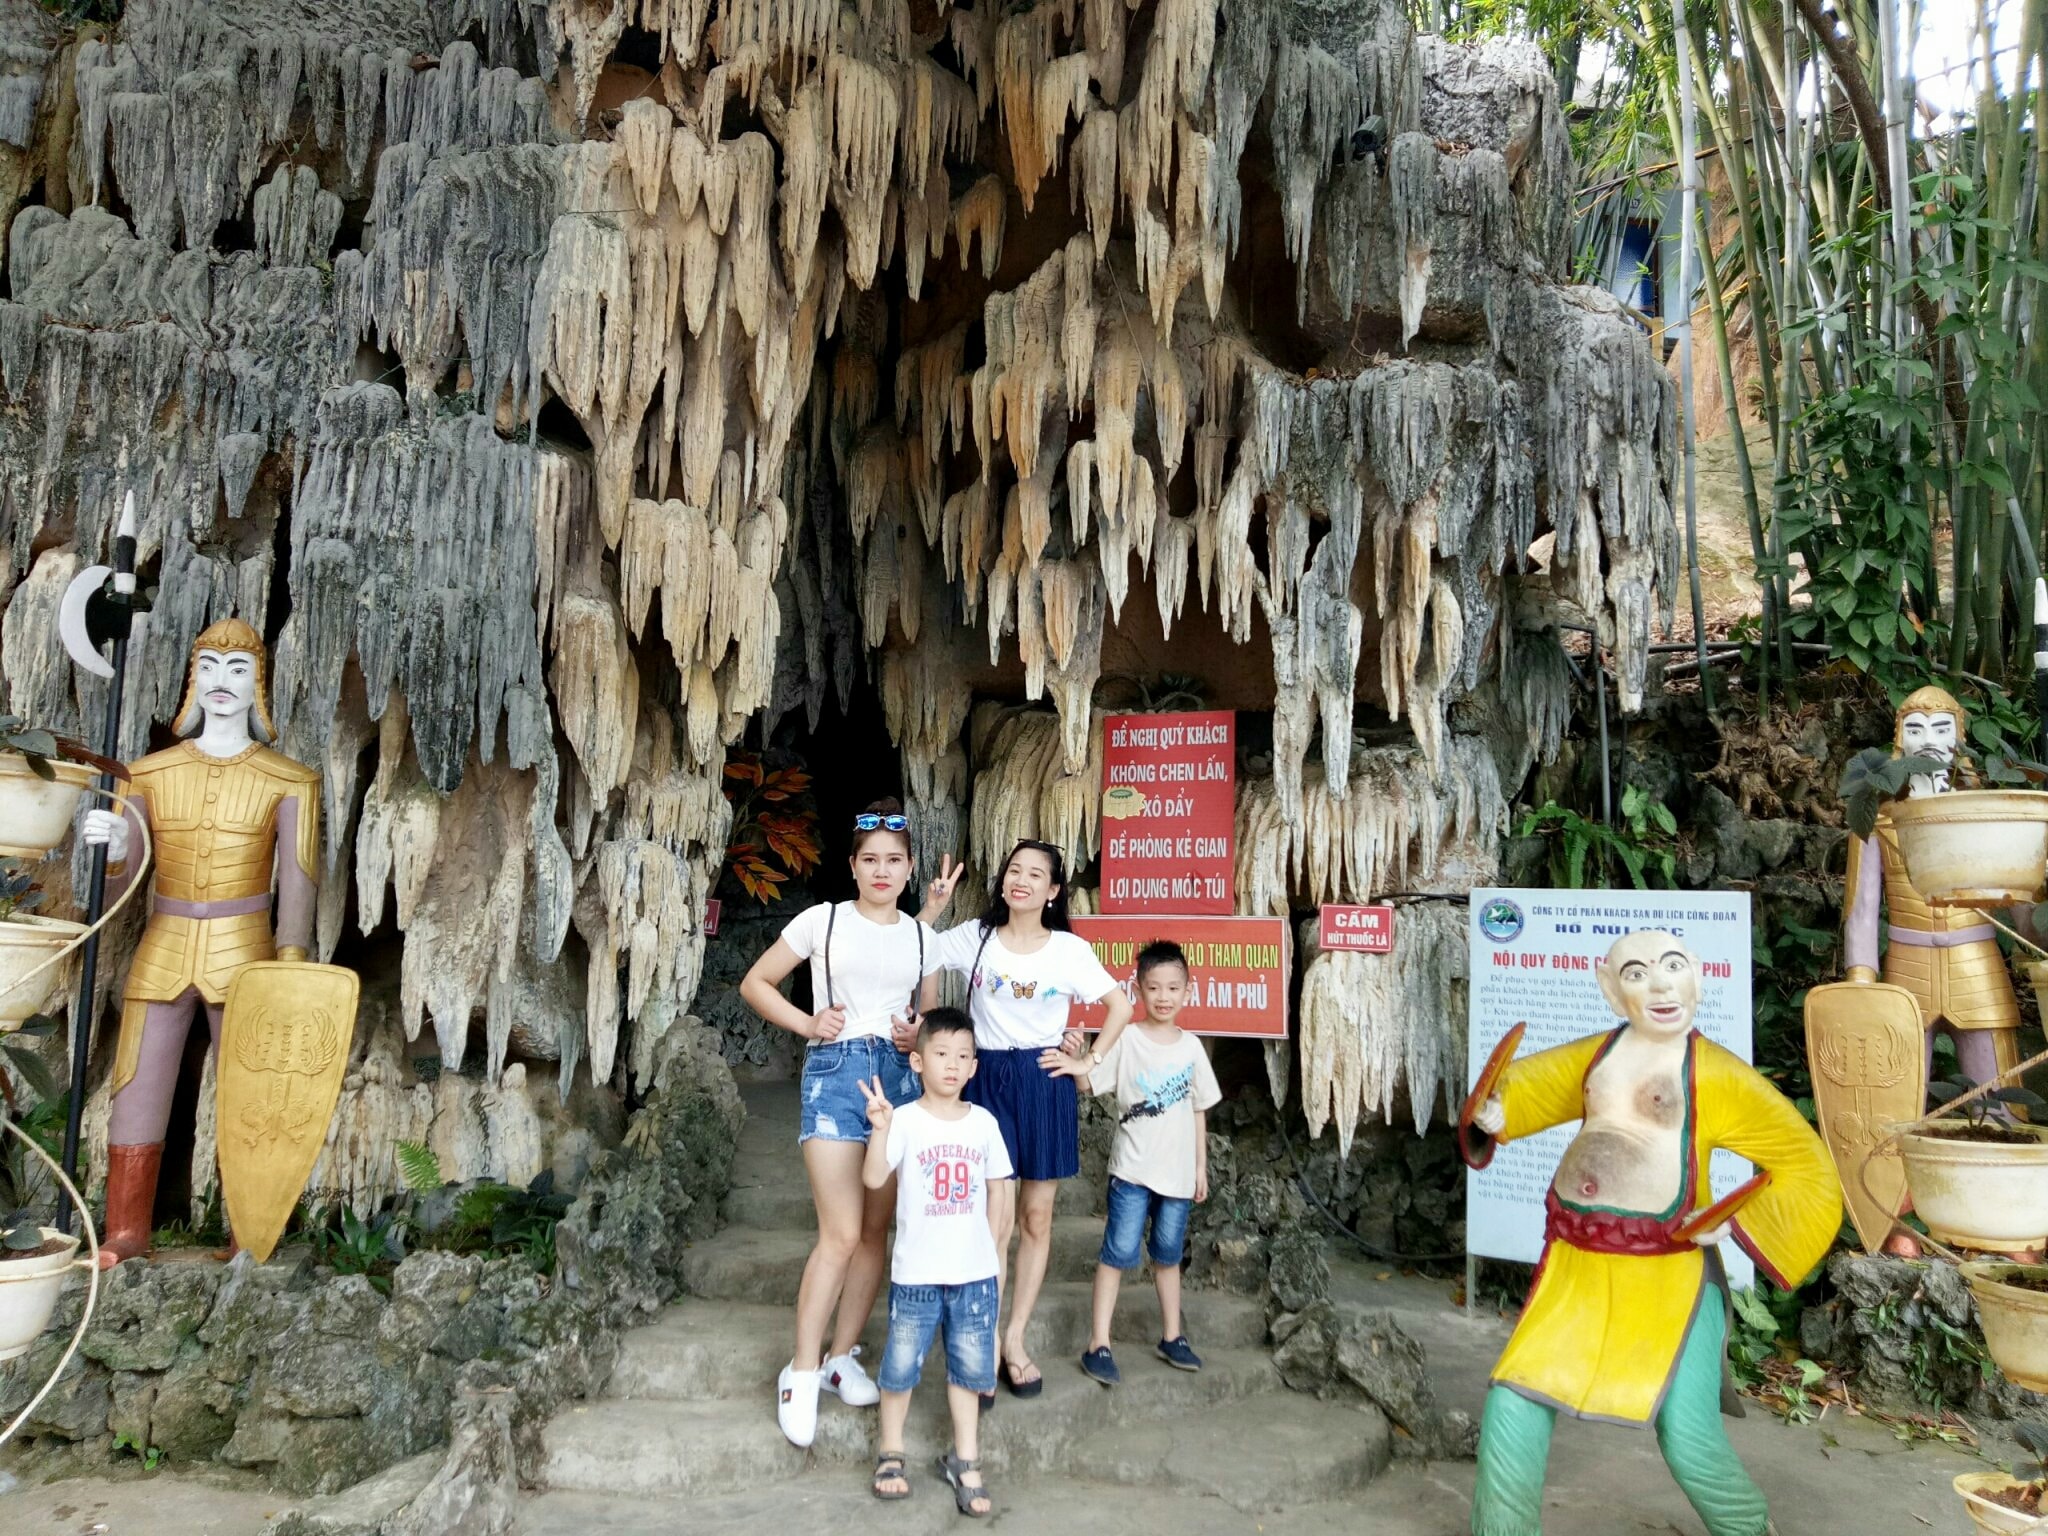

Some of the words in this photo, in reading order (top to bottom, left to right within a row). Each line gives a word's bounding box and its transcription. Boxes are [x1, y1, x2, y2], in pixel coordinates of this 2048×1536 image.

[1112, 720, 1128, 747] ĐỀ
[1130, 728, 1158, 750] NGHỊ
[1160, 721, 1184, 750] QUÝ
[1187, 720, 1227, 745] KHÁCH
[1110, 760, 1156, 782] KHÔNG
[1160, 763, 1194, 781] CHEN
[1198, 754, 1228, 782] LẤN,
[1143, 794, 1161, 817] XÔ
[1165, 787, 1194, 817] ĐẨY
[1110, 830, 1127, 858] ĐỀ
[1129, 832, 1172, 858] PHÒNG
[1176, 829, 1192, 858] KẺ
[1195, 837, 1227, 858] GIAN
[1110, 877, 1129, 905] LỢI
[1132, 878, 1169, 905] DỤNG
[1171, 872, 1201, 899] MÓC
[1204, 872, 1225, 899] TÚI
[1335, 910, 1379, 928] CẤM
[1327, 931, 1344, 944] HÚT
[1346, 931, 1374, 945] THUỐC
[1376, 932, 1387, 946] LÁ
[1112, 937, 1134, 968] QUÝ
[1209, 943, 1241, 967] THAM
[1245, 943, 1279, 971] QUAN
[1493, 950, 1515, 970] NỘI
[1520, 953, 1546, 969] QUY
[1552, 952, 1589, 973] ĐỘNG
[1702, 959, 1731, 978] PHỦ
[1207, 976, 1232, 1008] ÂM
[1236, 974, 1268, 1010] PHỦ
[934, 1161, 969, 1201] 89
